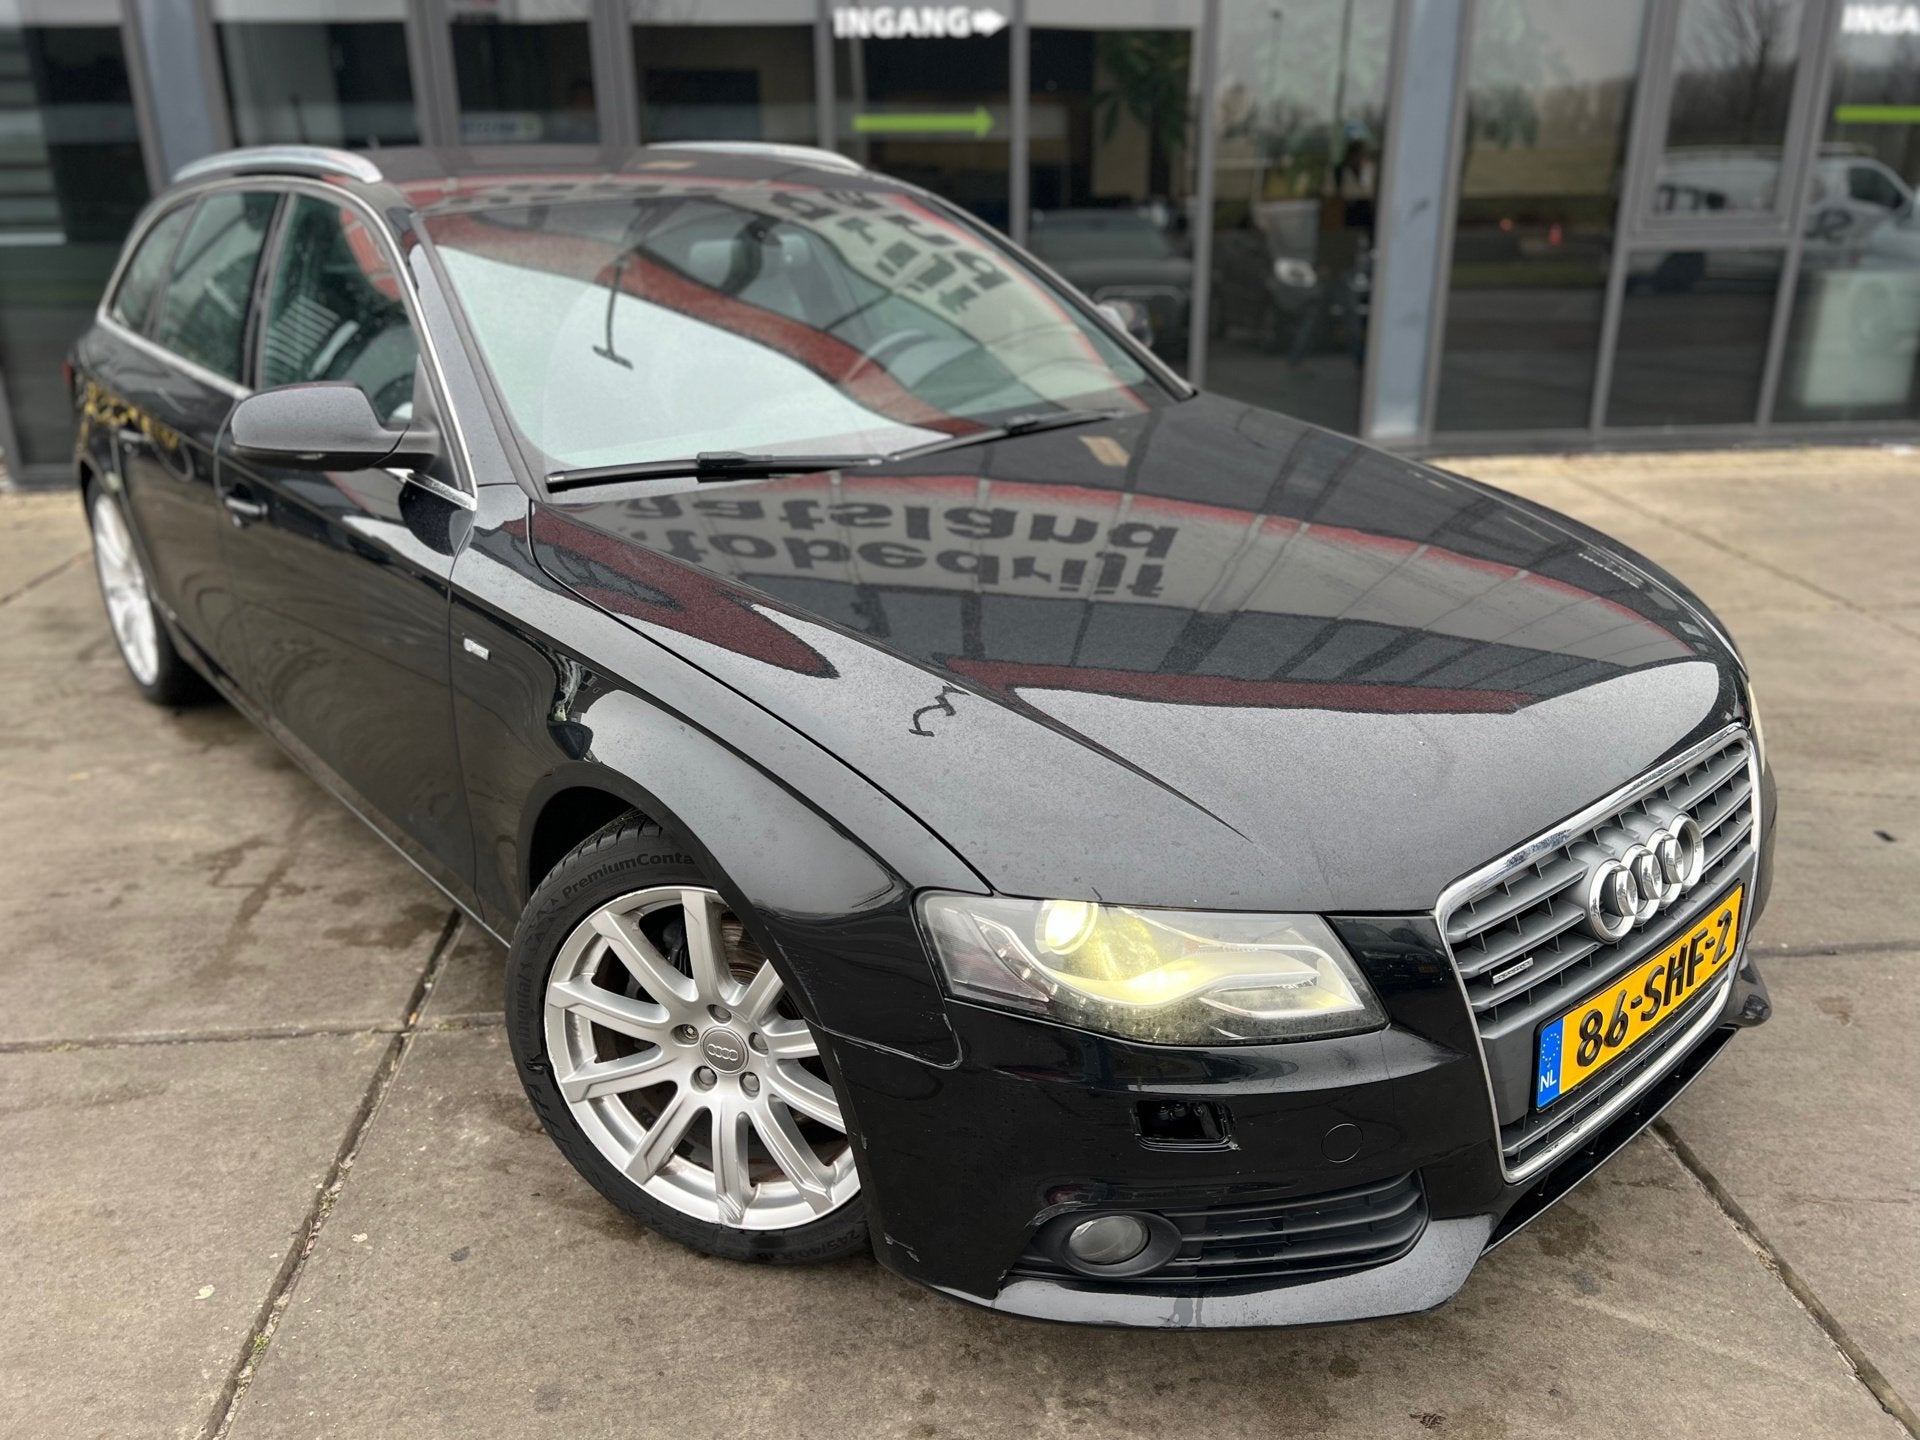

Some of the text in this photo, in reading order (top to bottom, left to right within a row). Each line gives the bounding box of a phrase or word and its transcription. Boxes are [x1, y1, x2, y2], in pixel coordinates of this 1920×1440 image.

[833, 6, 972, 39] INGANG
[1576, 908, 1733, 1067] 86-SHF-2
[1539, 1069, 1557, 1092] NL
